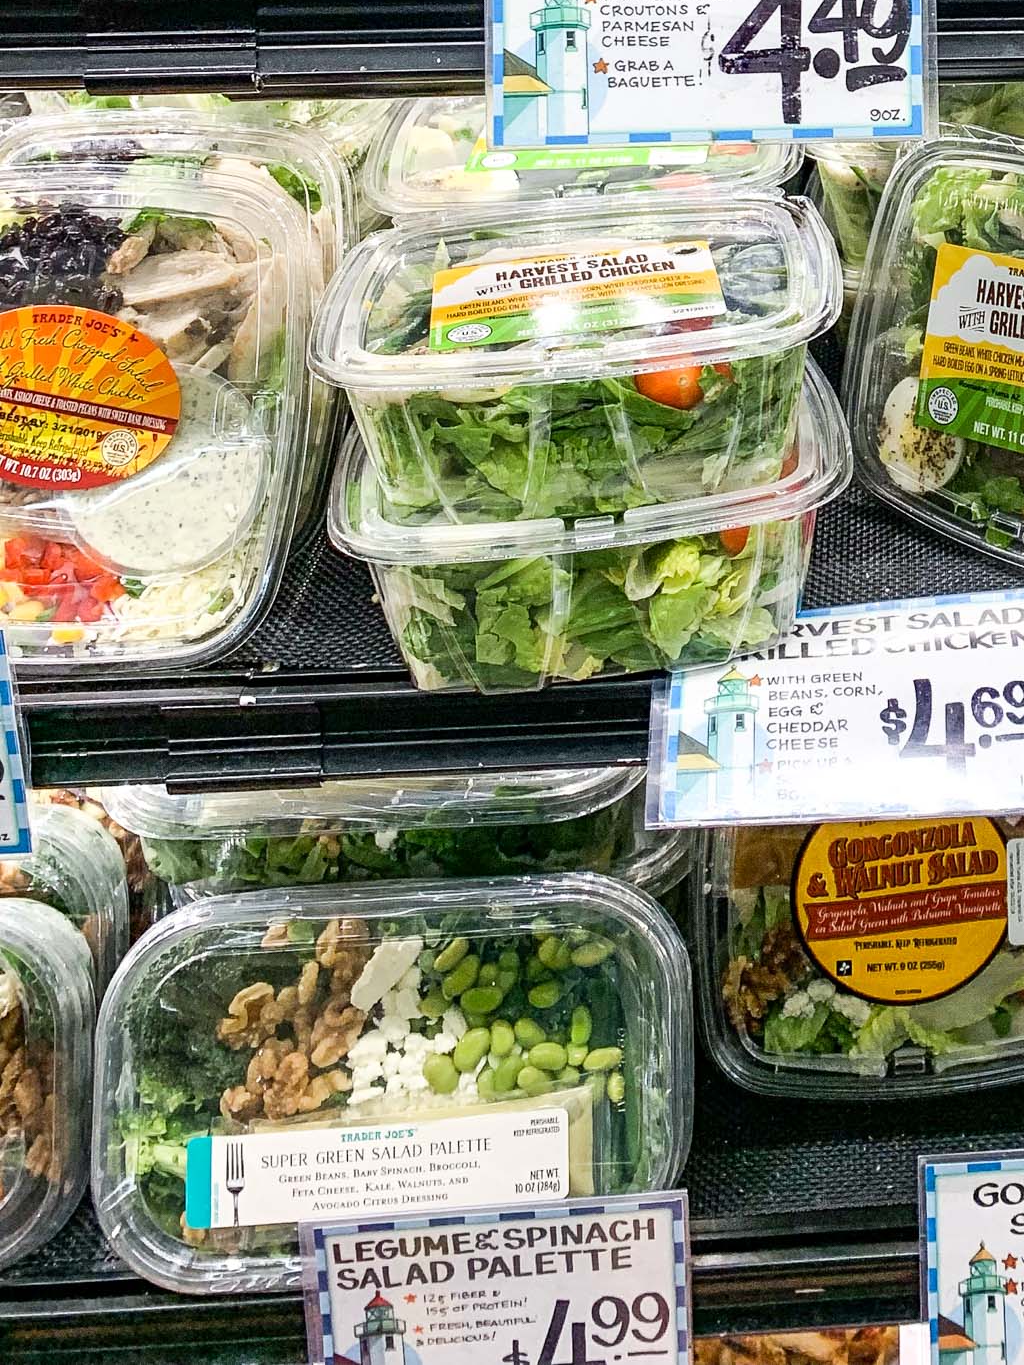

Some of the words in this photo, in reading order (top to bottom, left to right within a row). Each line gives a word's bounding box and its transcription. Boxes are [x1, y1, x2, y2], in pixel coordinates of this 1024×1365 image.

[602, 20, 694, 32] PARMESAN
[602, 36, 669, 48] CHEESE
[33, 314, 82, 325] TRADER
[86, 319, 121, 337] JOE'S
[959, 311, 985, 329] WITH
[62, 330, 122, 365] Chopped
[58, 368, 94, 392] White
[98, 377, 145, 402] Chicken
[974, 422, 990, 435] NET
[992, 427, 1006, 440] WT.
[1009, 431, 1016, 442] 11
[767, 674, 807, 685] WITH
[811, 672, 863, 683] GREEN
[769, 687, 828, 698] BEANS,
[833, 685, 883, 696] CORN,
[767, 719, 848, 734] CHEDDAR
[767, 738, 838, 749] CHEESE
[341, 1130, 380, 1142] TRADER
[384, 1129, 416, 1141] JOE'S
[261, 1153, 307, 1169] SUPER
[317, 1149, 365, 1165] GREEN
[371, 1143, 423, 1160] SALAD
[431, 1138, 492, 1155] PALETTE
[332, 1233, 474, 1265] LEGUME
[503, 1218, 655, 1248] SPINACH
[336, 1260, 455, 1289] SALAD
[468, 1246, 632, 1280] PALETTE
